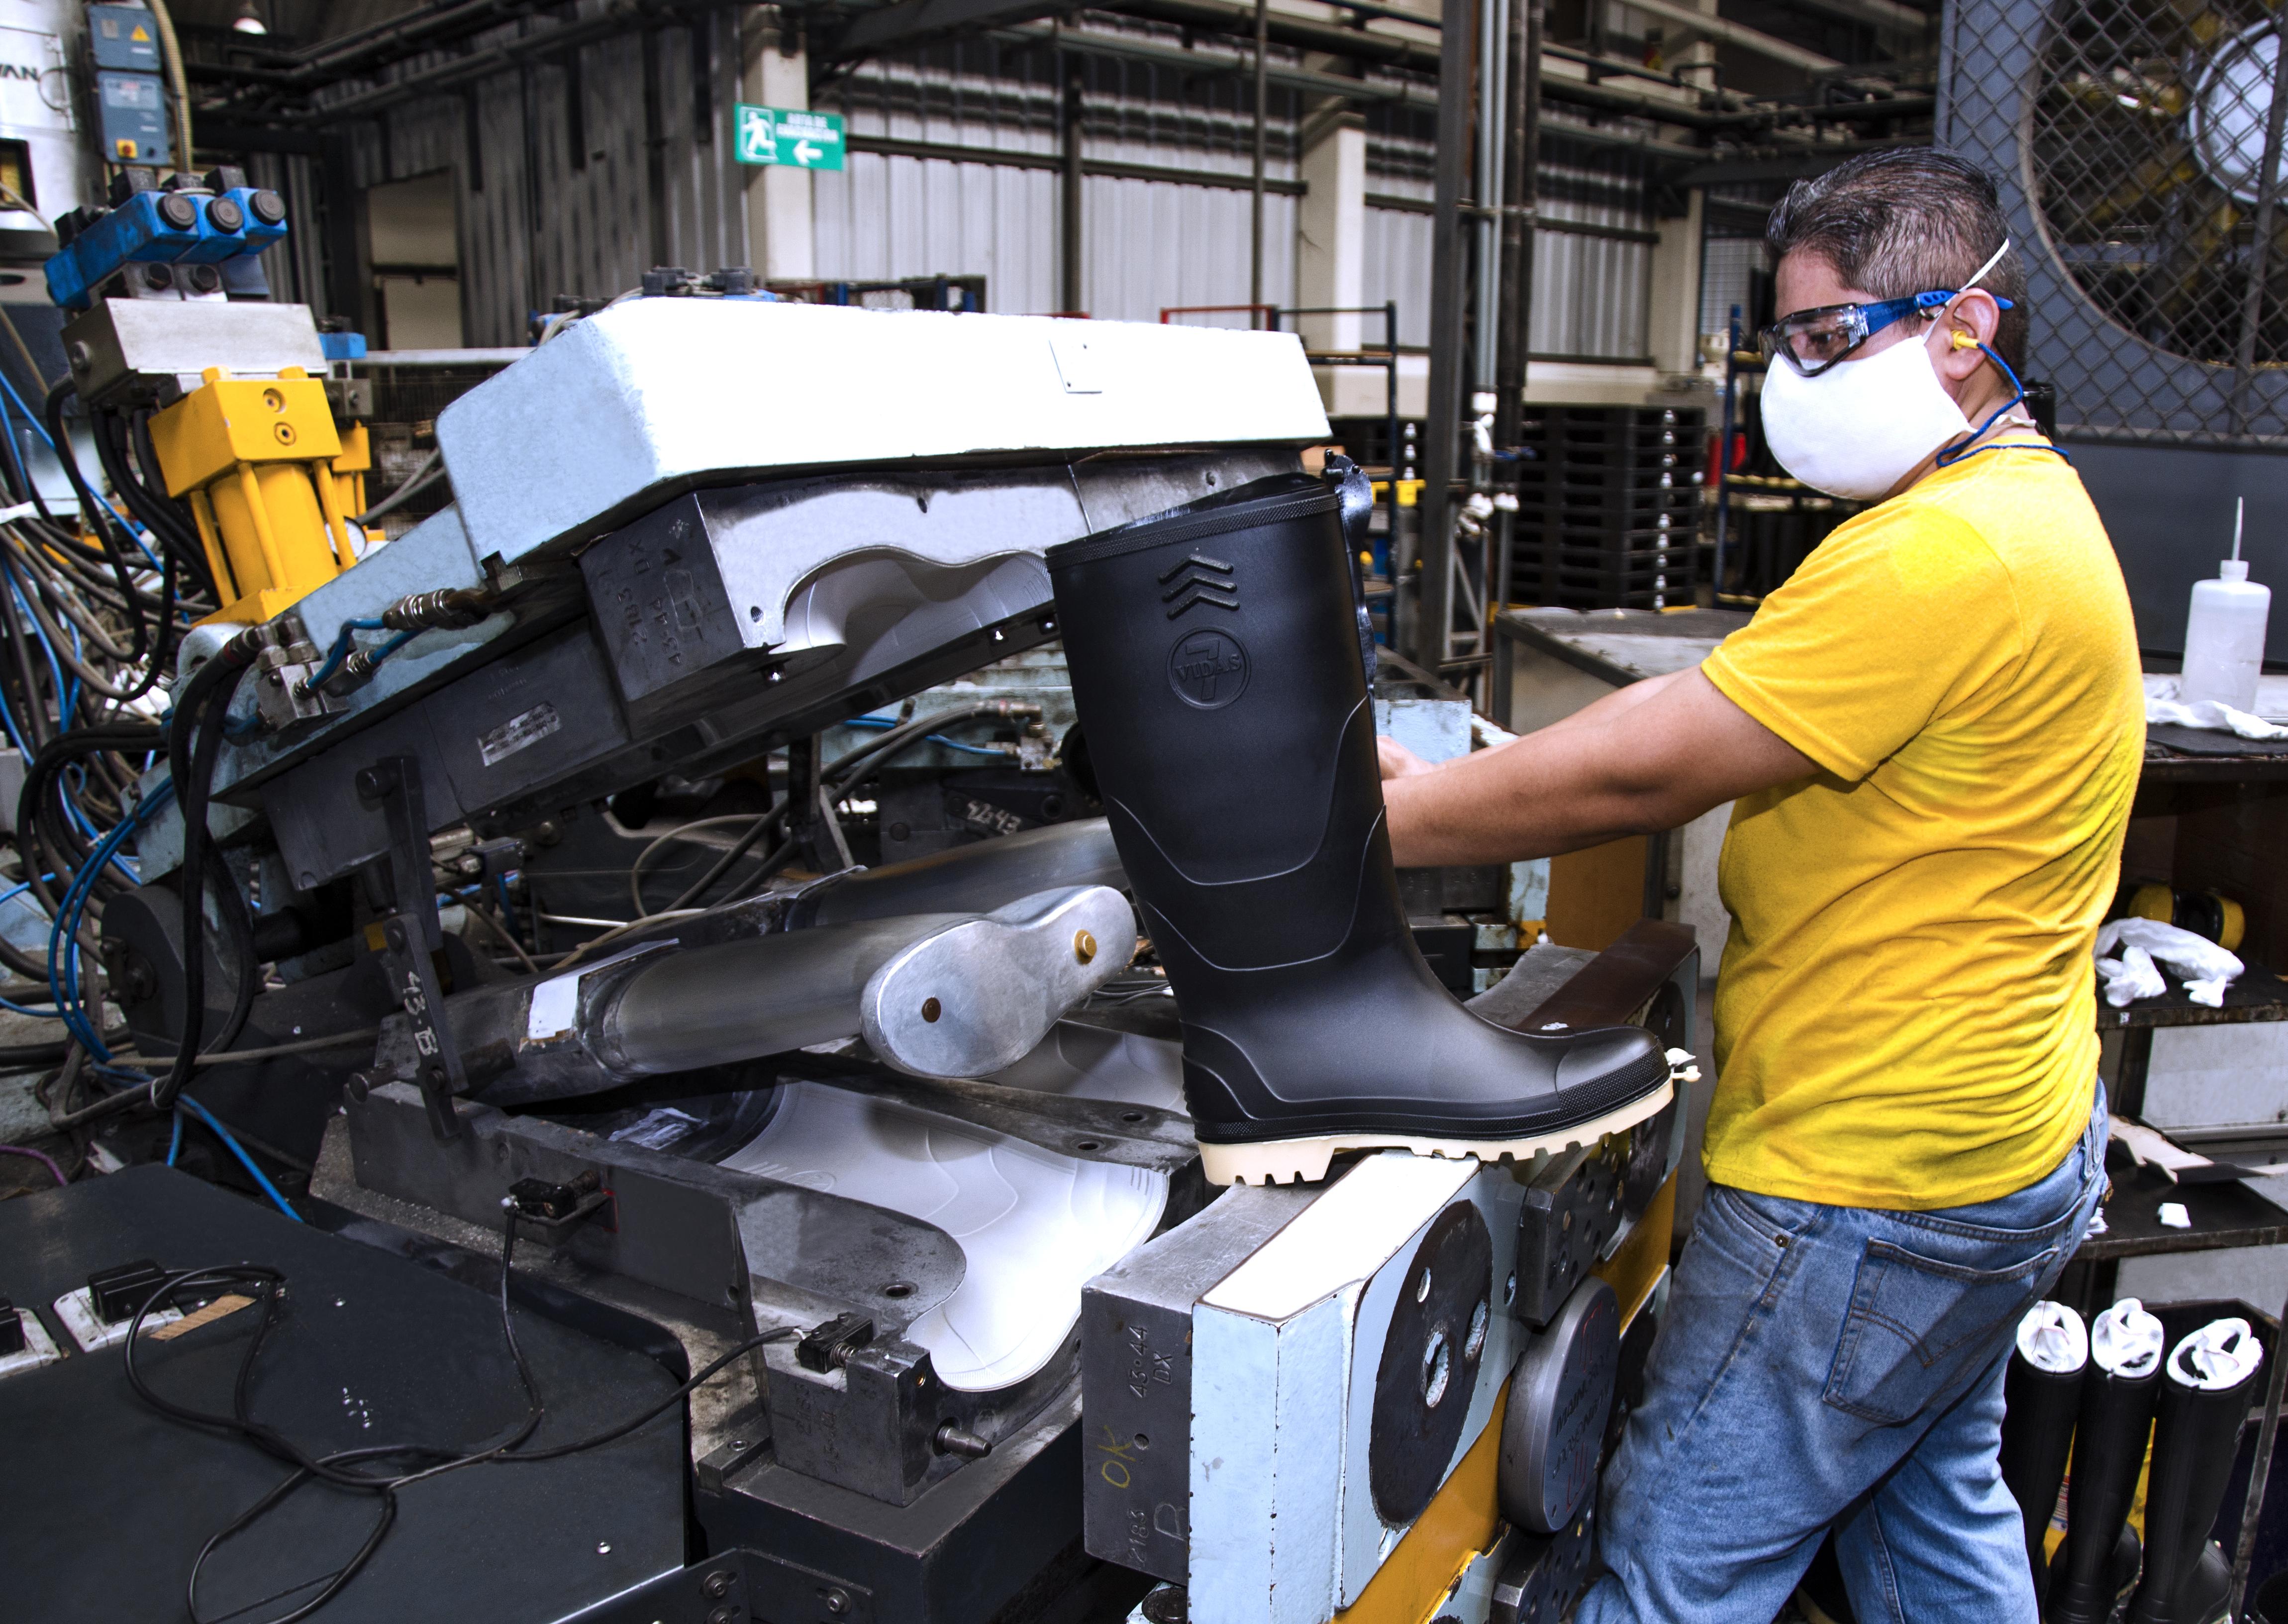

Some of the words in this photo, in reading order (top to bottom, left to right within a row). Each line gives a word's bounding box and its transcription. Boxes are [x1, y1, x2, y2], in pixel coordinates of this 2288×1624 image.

[1174, 653, 1242, 681] VIDAS
[1152, 1351, 1173, 1385] DX
[1096, 1424, 1137, 1489] OK
[1127, 1509, 1149, 1564] 2183
